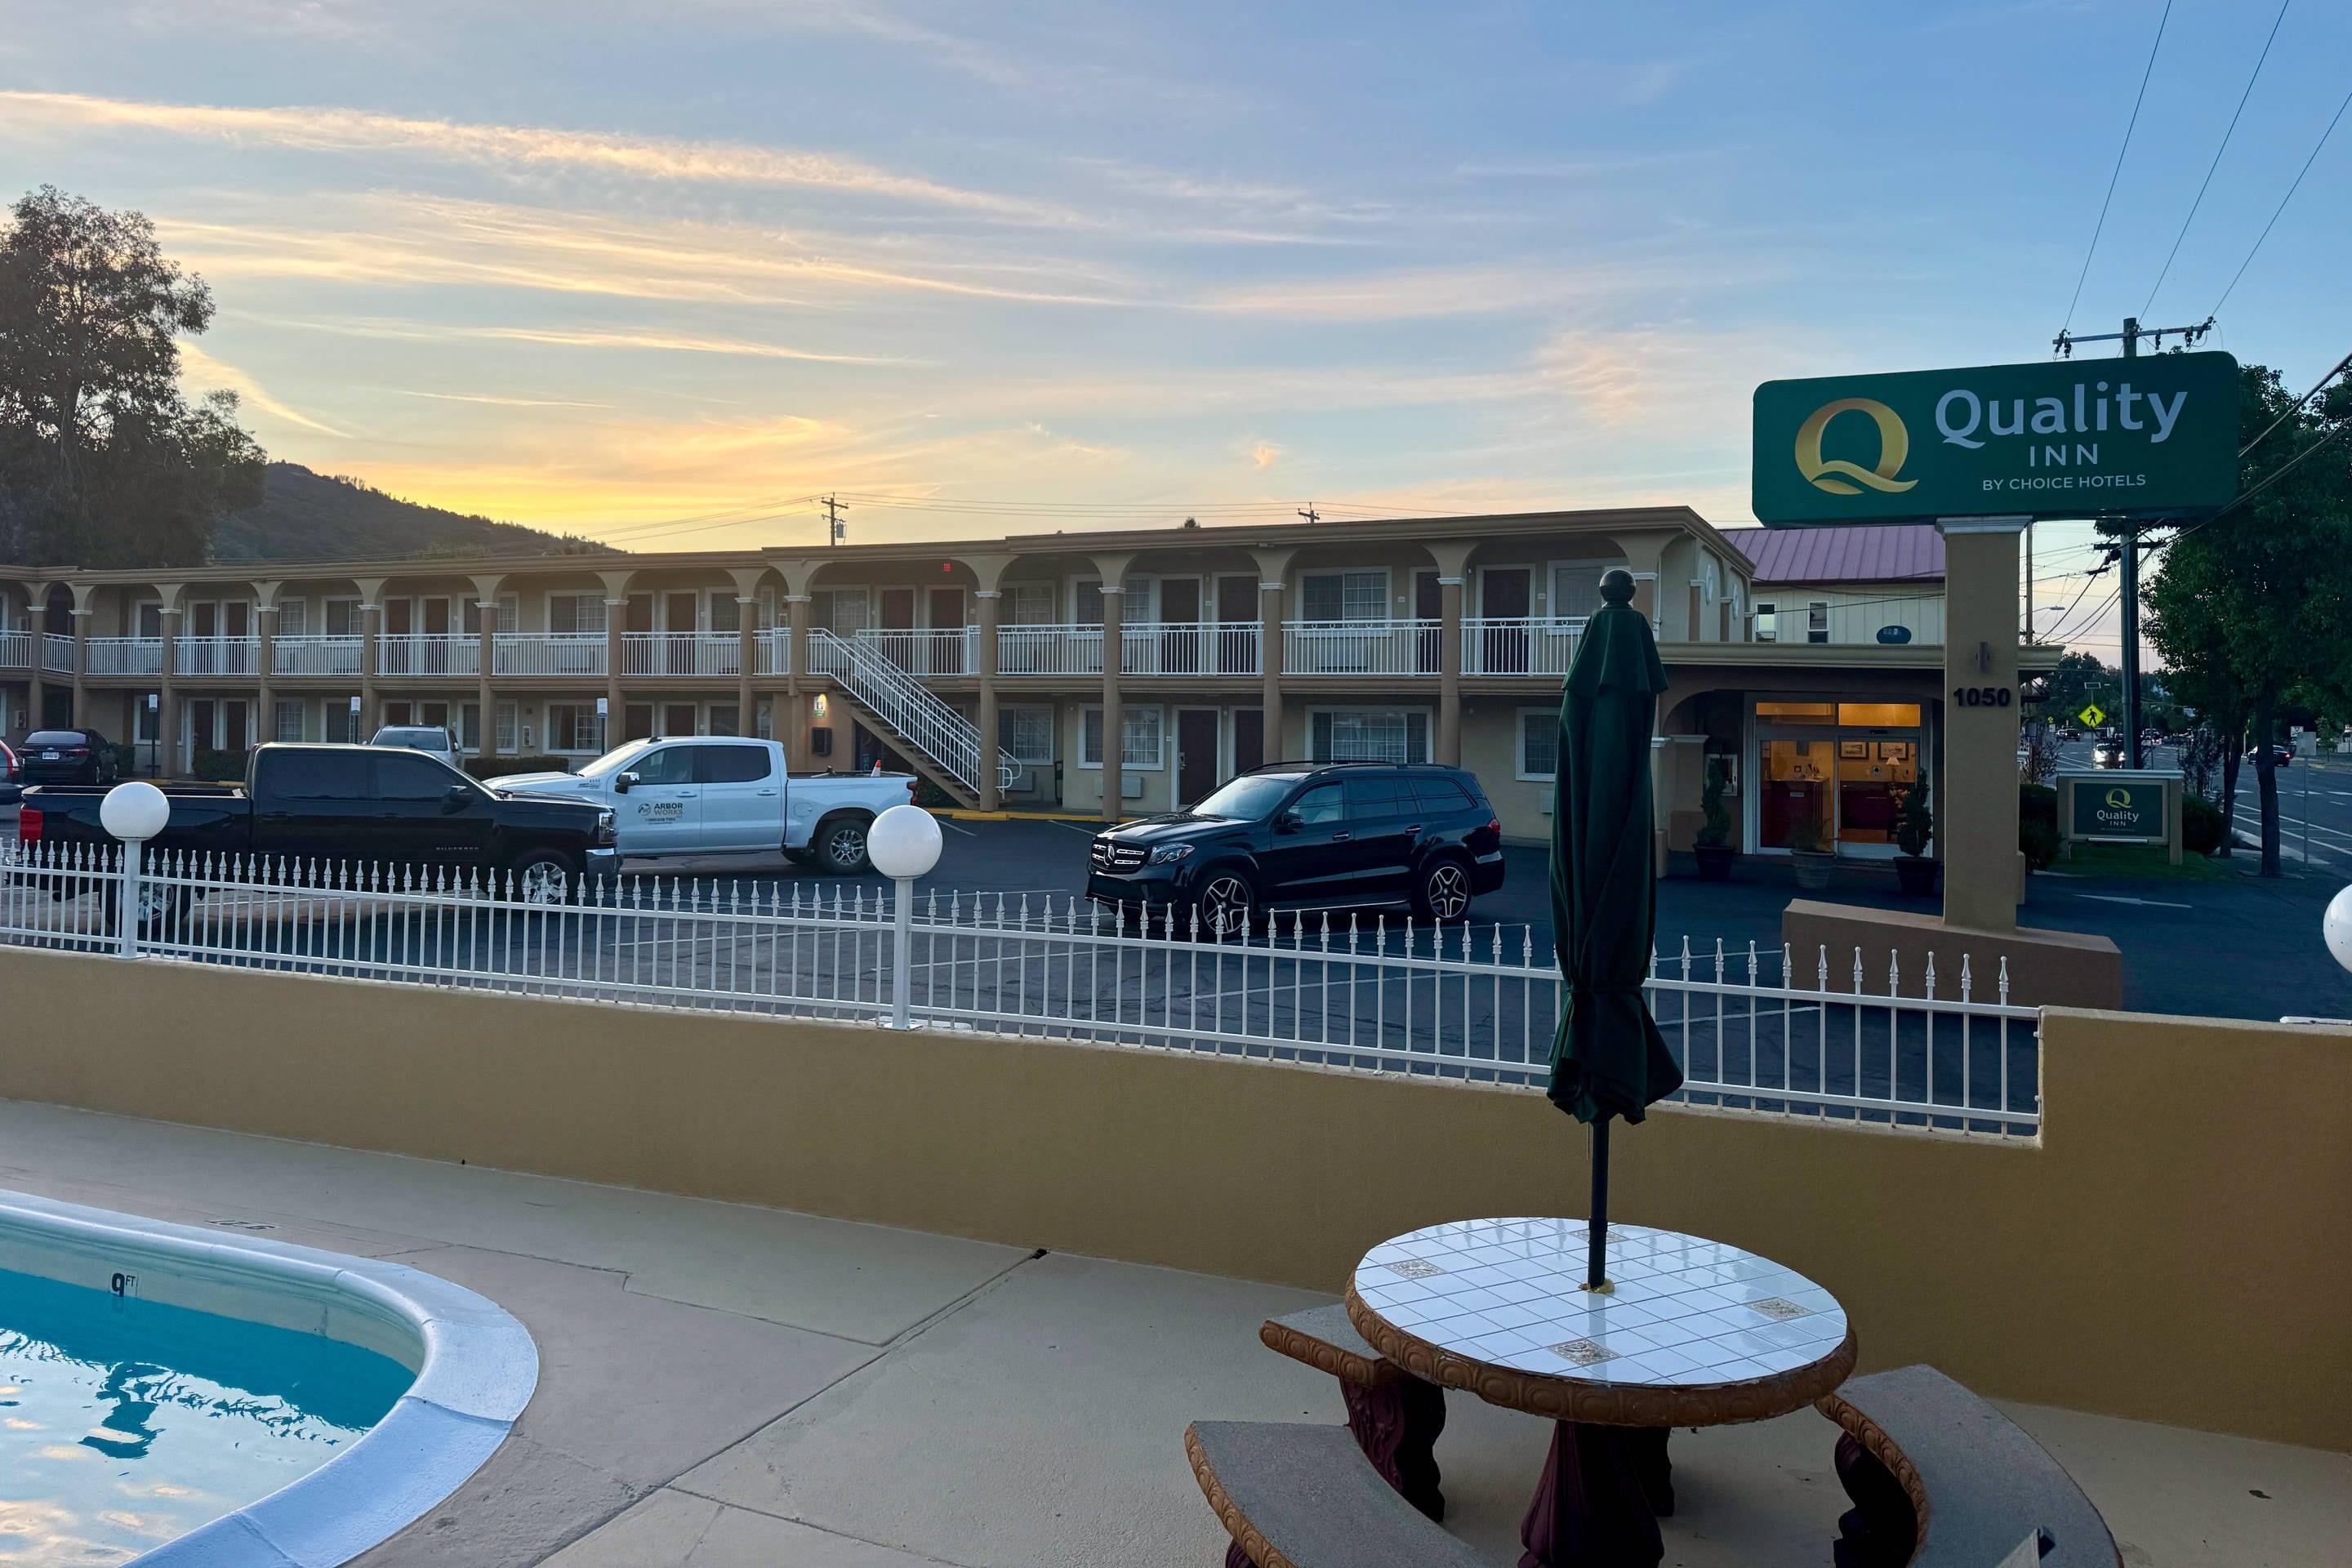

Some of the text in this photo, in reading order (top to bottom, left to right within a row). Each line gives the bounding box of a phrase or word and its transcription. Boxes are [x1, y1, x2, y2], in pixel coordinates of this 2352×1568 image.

[1935, 381, 2189, 449] Quality
[1794, 397, 1919, 496] Q
[2029, 443, 2098, 467] INN
[1982, 474, 2146, 491] BY CHOICE HOTELS
[1953, 687, 2011, 707] 1050
[2105, 787, 2133, 808] Q
[2096, 809, 2140, 822] Quality
[125, 1275, 136, 1288] FT
